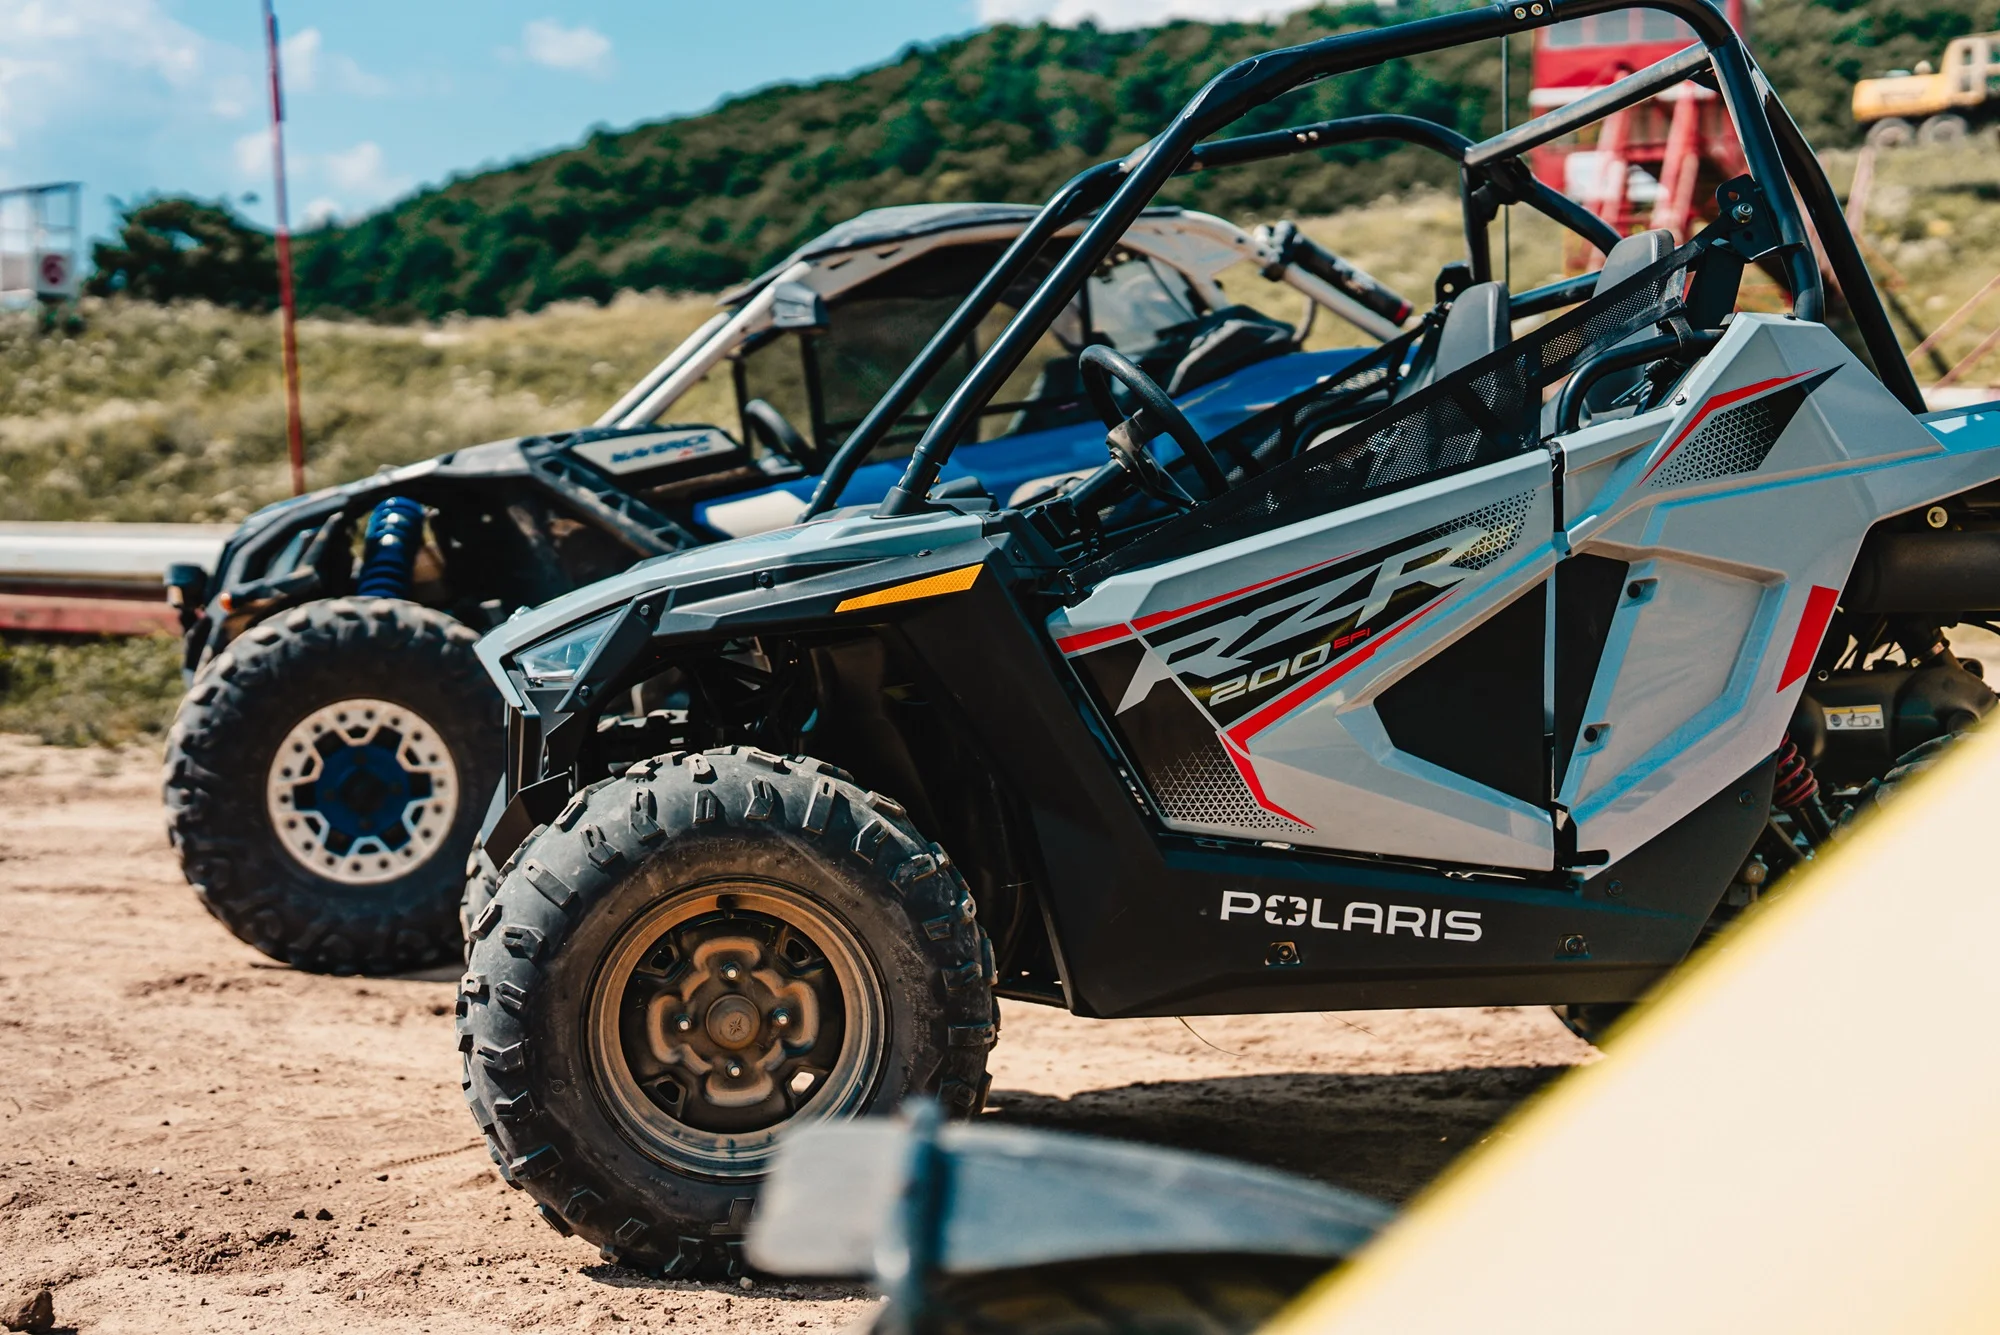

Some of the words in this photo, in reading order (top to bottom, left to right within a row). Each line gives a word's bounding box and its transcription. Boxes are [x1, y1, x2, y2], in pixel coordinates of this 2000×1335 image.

[1114, 525, 1488, 717] RZR
[1209, 643, 1332, 707] 200
[1333, 628, 1371, 650] EFI
[1220, 890, 1483, 943] POLARIS
